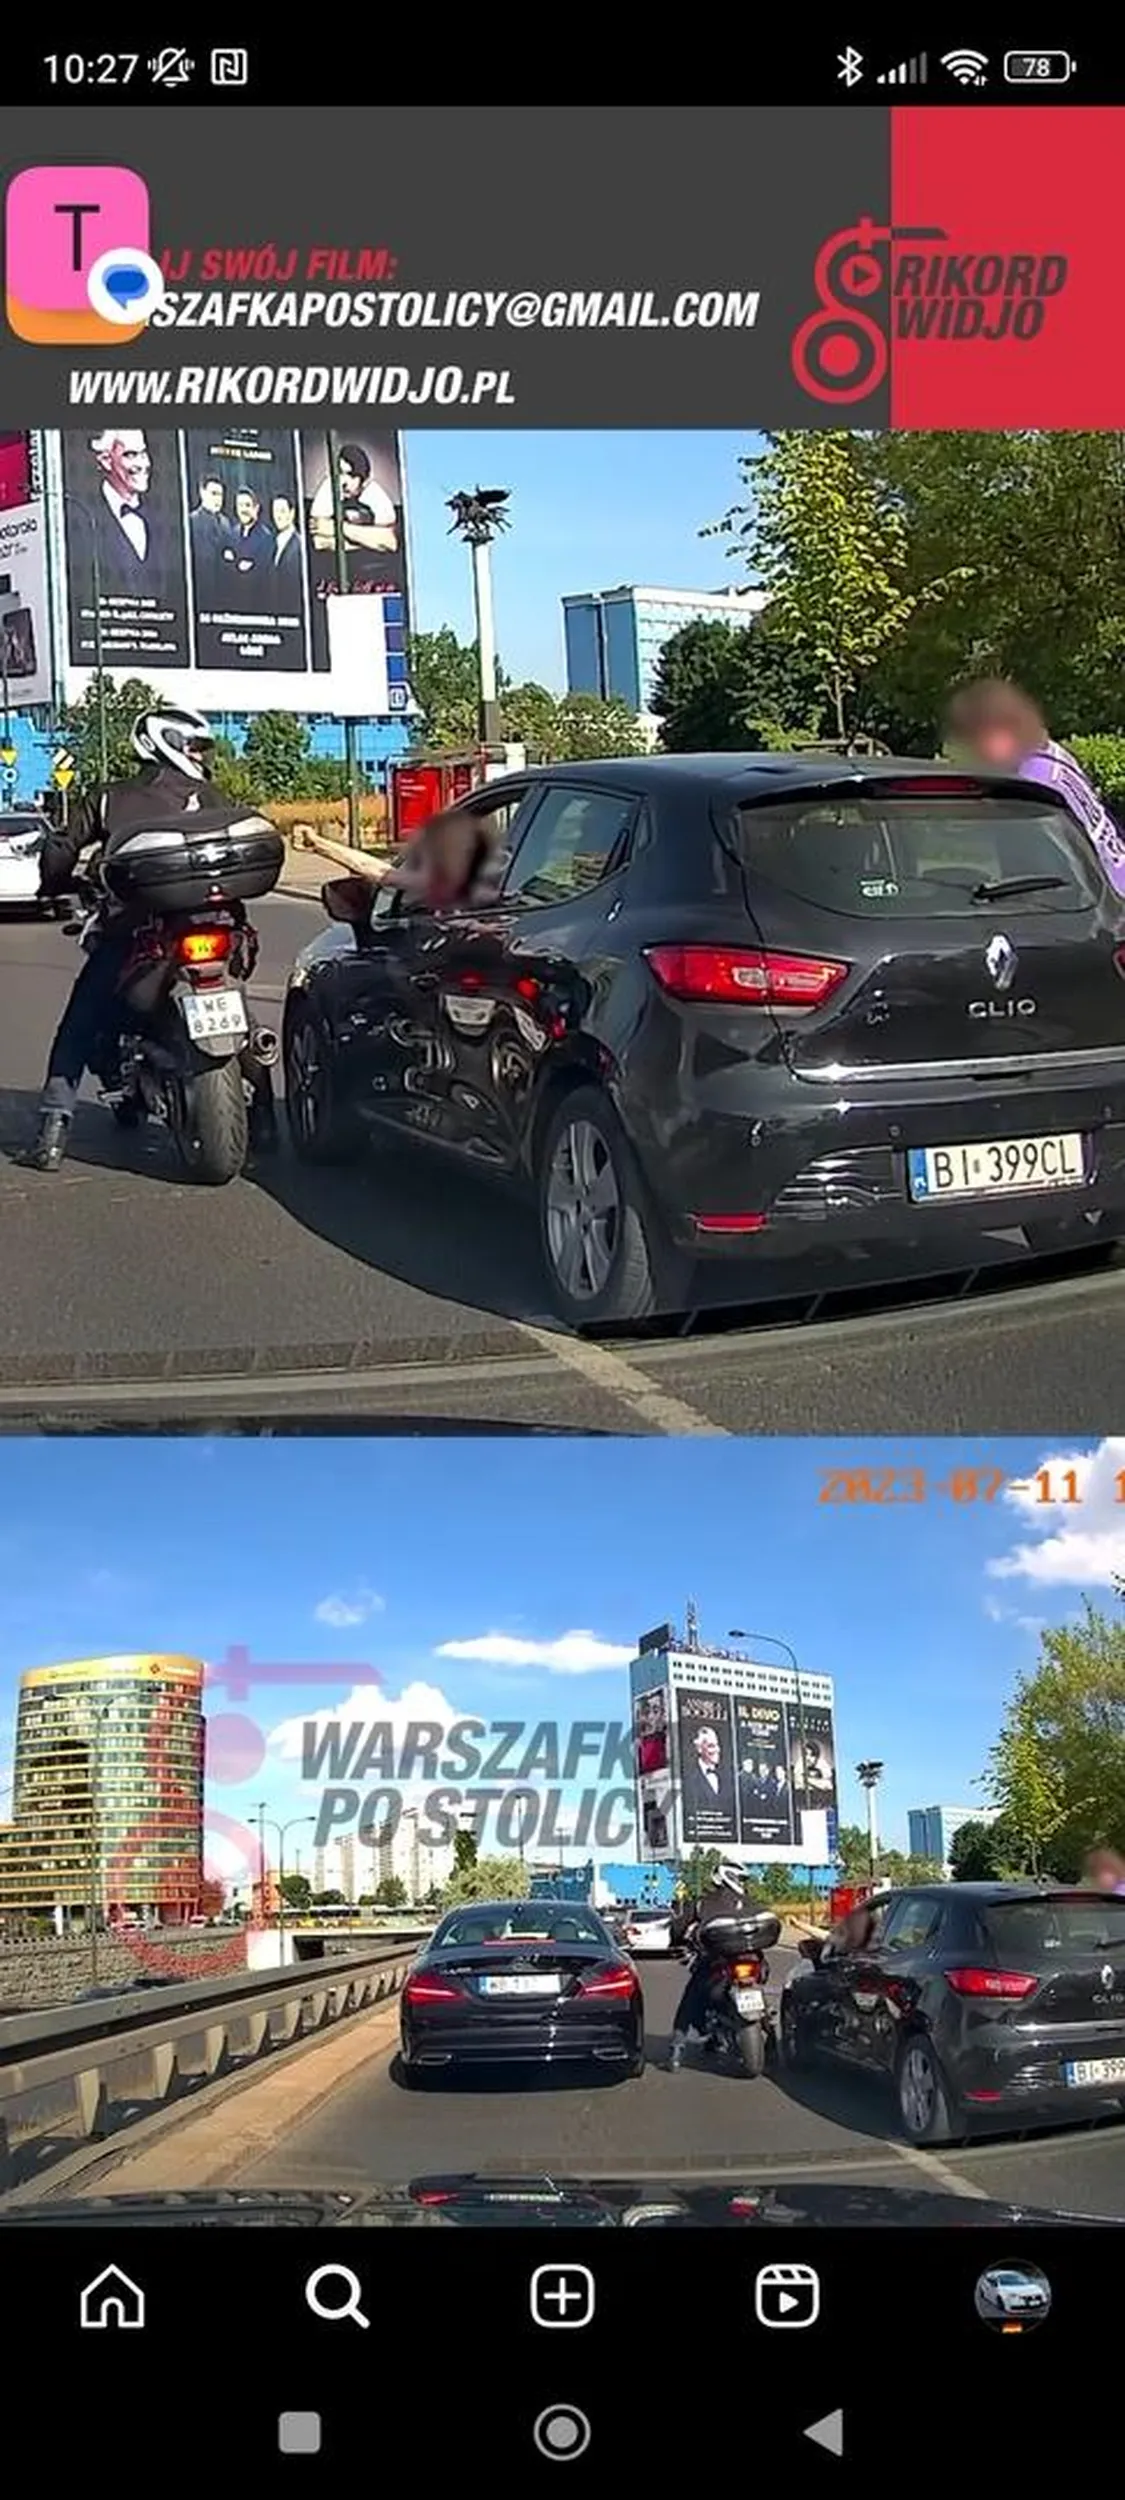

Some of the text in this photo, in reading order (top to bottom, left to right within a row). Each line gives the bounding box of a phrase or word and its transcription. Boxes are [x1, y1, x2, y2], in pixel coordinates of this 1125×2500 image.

[968, 999, 1036, 1018] CLIO
[933, 1139, 1076, 1188] BI 399CL
